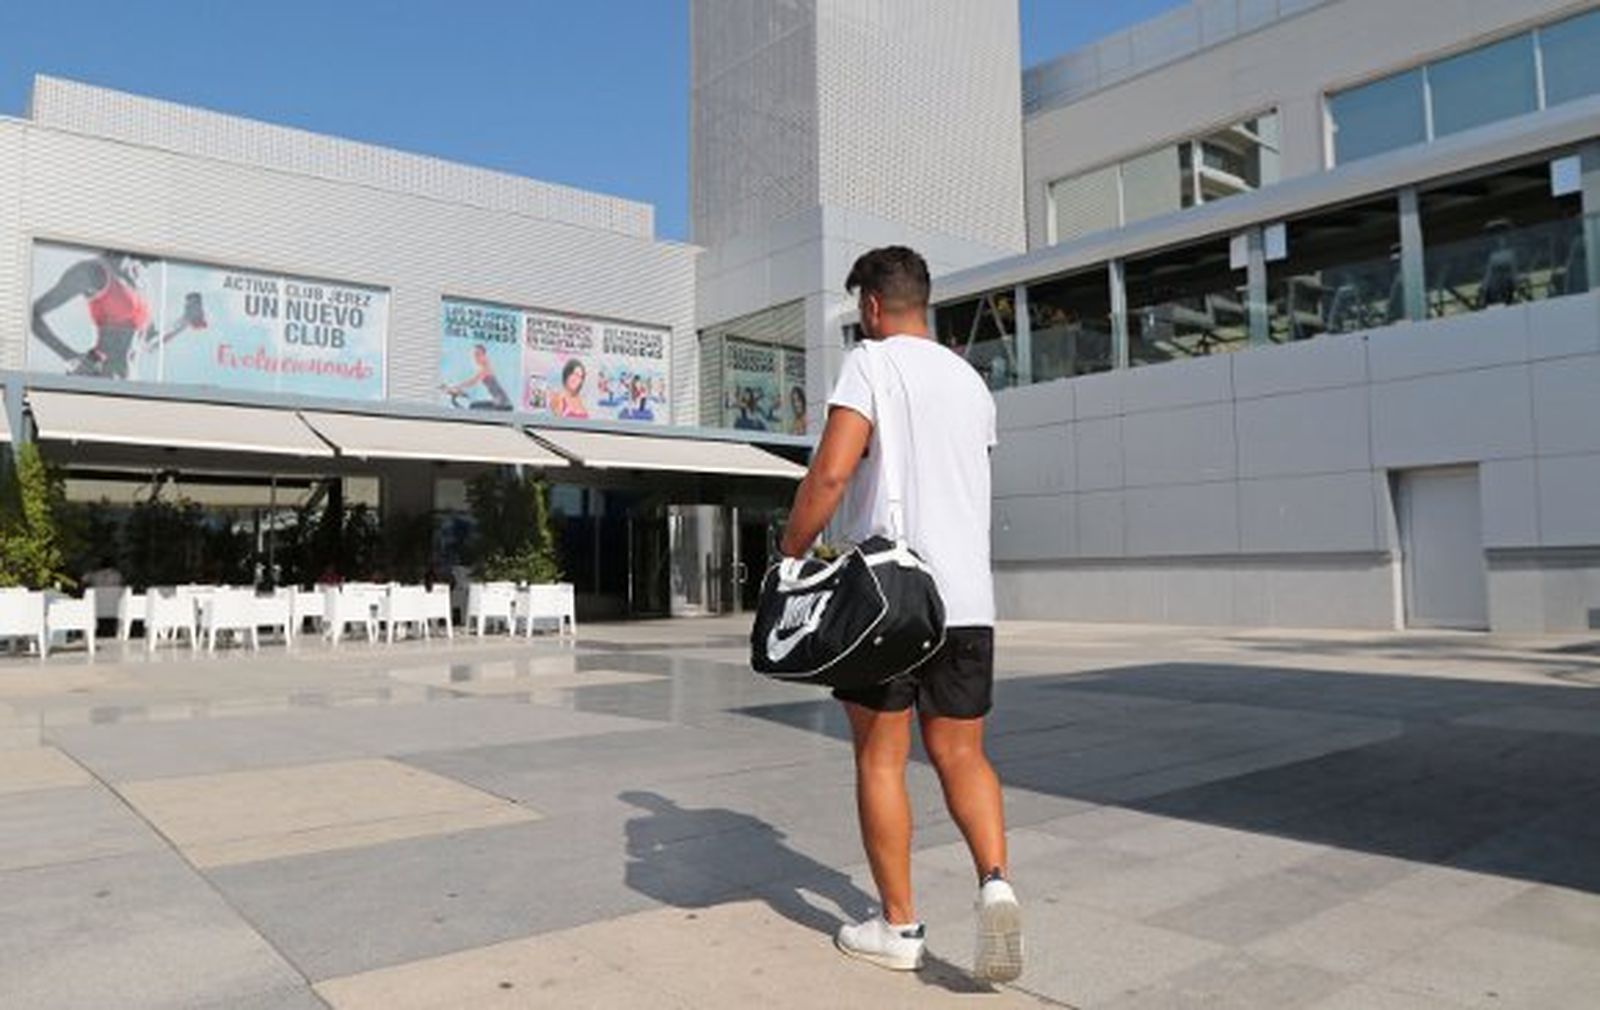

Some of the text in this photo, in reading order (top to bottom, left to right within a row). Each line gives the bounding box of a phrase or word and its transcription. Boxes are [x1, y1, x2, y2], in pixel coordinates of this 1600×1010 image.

[224, 277, 372, 308] ACTIVA CLUB JEREZ
[245, 295, 364, 329] UN NUEVO
[285, 322, 345, 349] CLUB
